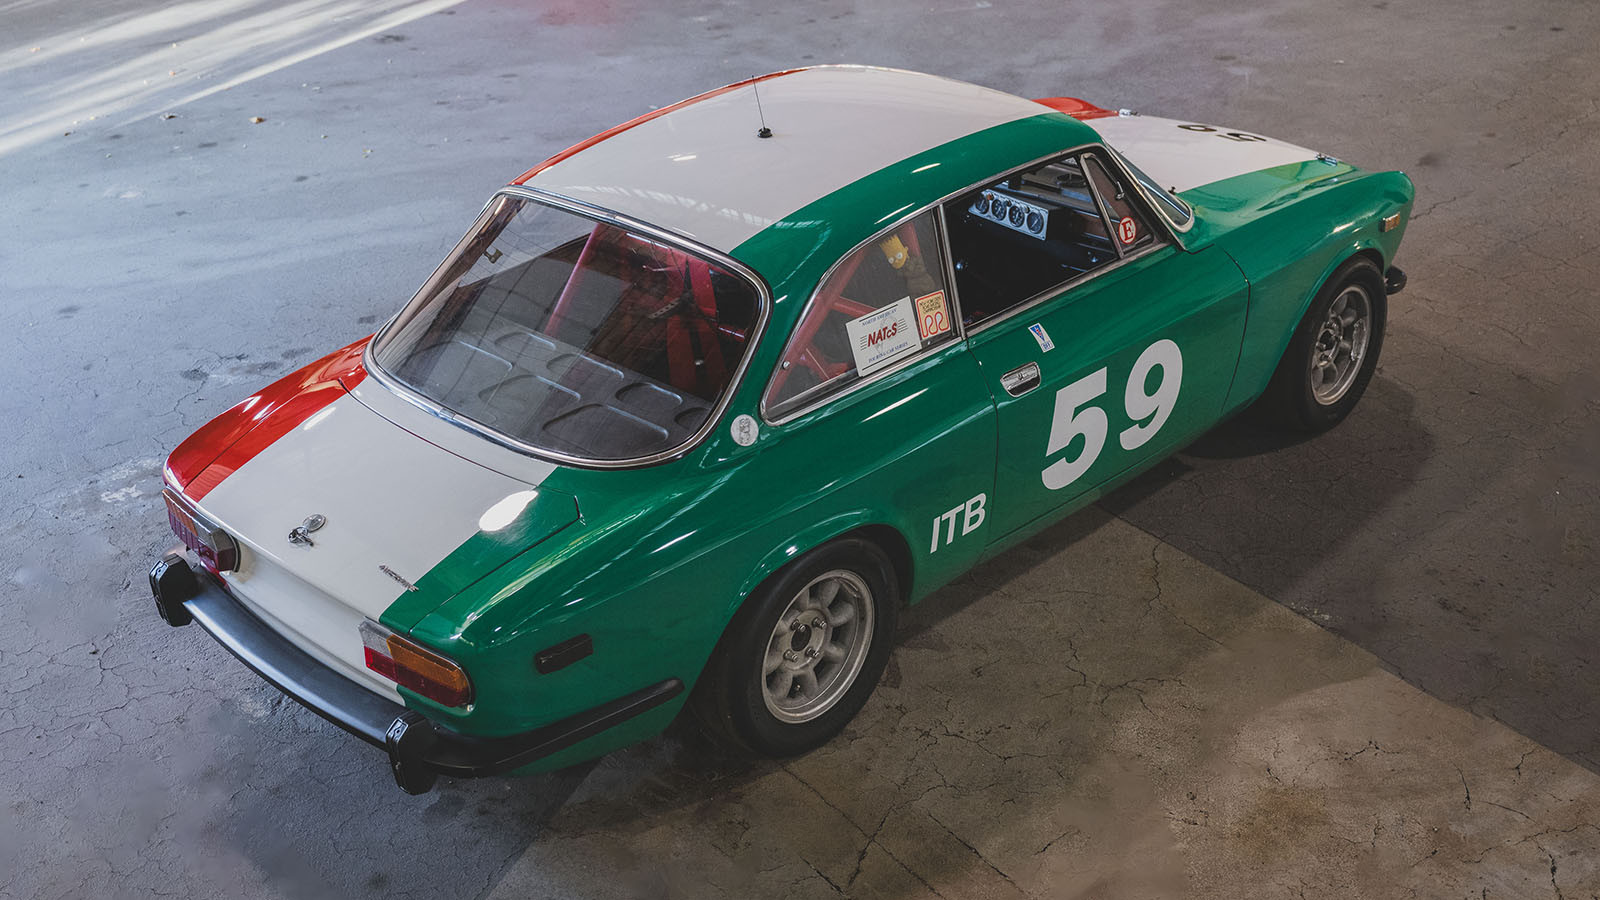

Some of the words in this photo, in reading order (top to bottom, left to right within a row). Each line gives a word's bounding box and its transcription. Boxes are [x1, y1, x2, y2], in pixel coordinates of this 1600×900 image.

[1121, 220, 1134, 241] E
[867, 322, 897, 347] NATcS
[1041, 338, 1183, 490] 59
[930, 492, 987, 554] ITB
